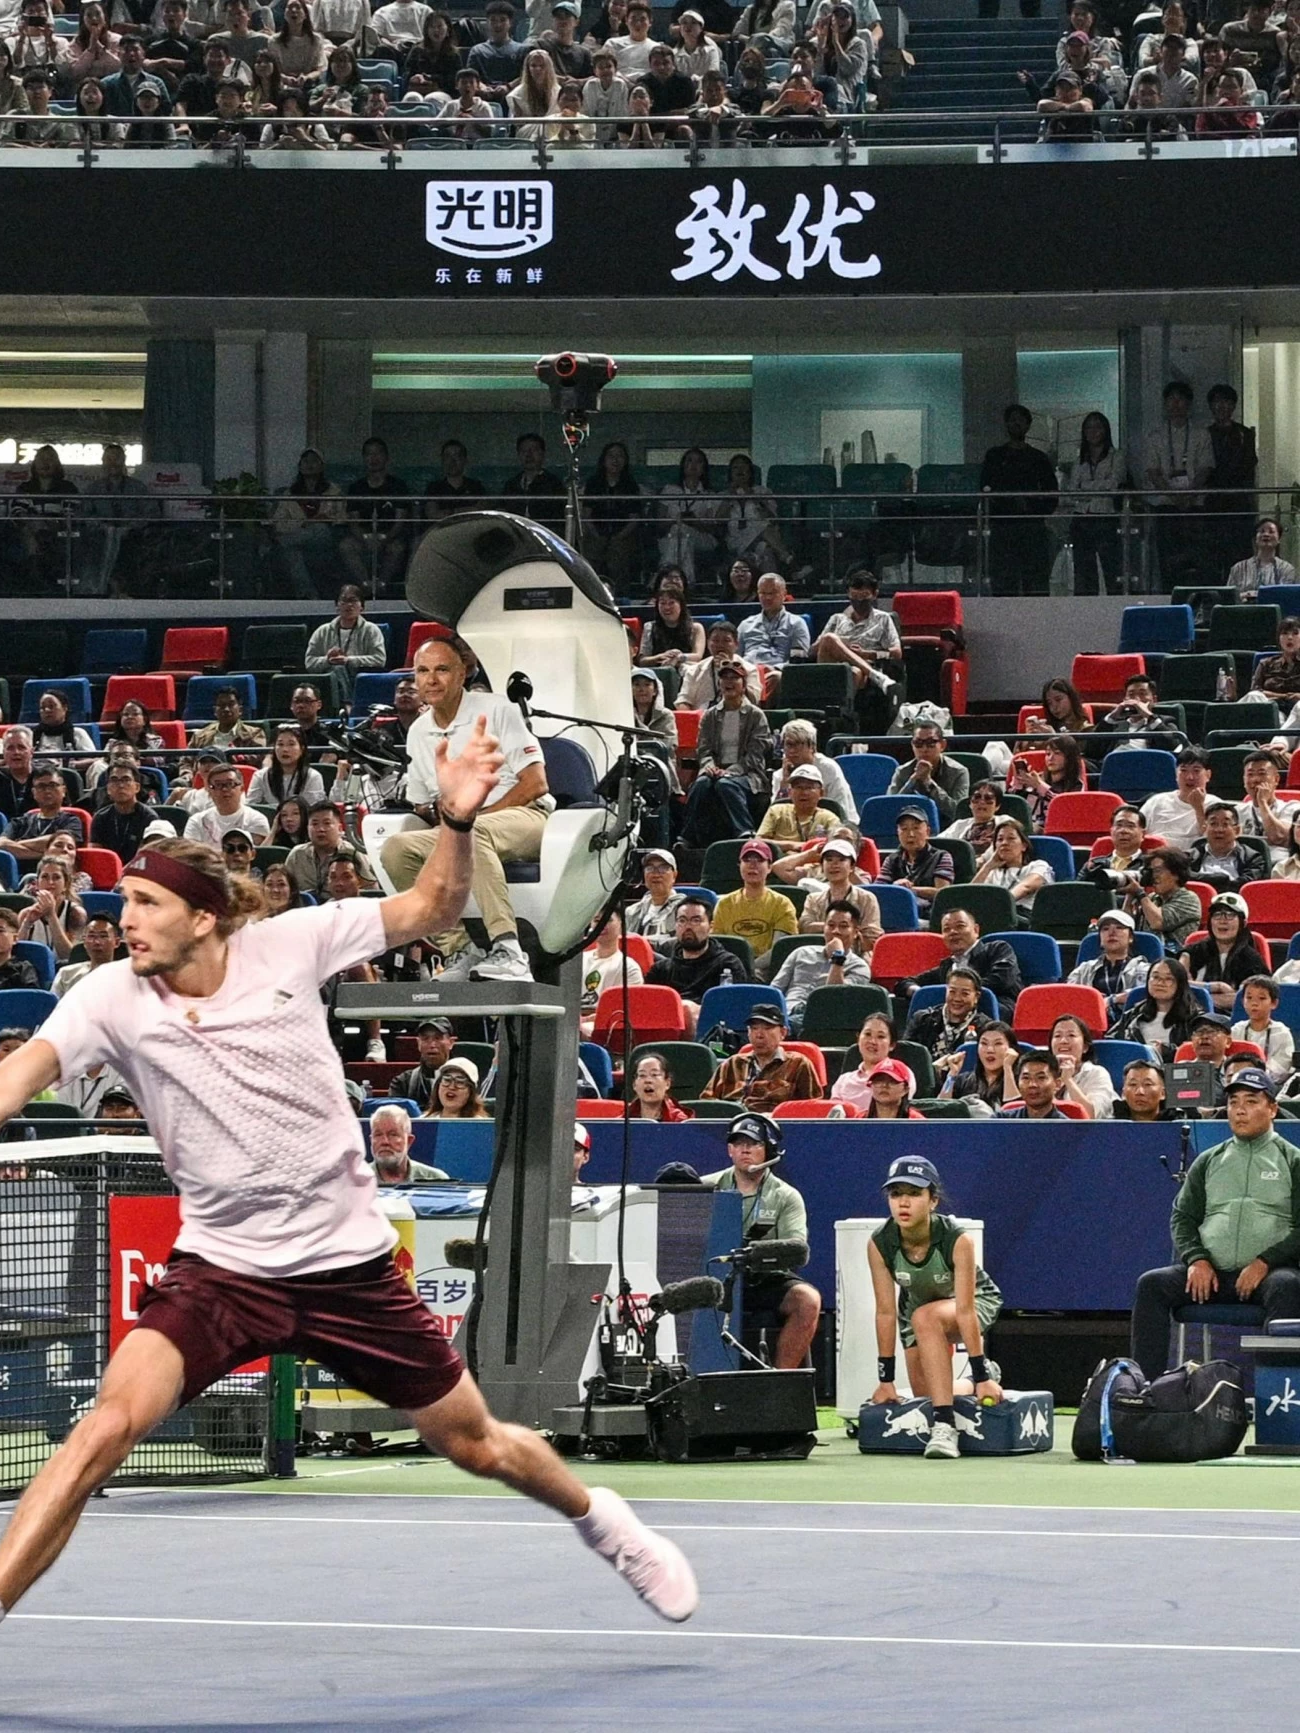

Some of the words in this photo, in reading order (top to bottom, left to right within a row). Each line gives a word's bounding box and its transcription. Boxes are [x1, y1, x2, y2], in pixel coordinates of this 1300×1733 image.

[435, 188, 542, 230] 光明
[671, 178, 881, 281] 致优
[434, 267, 543, 284] 乐在新鲜
[907, 1165, 924, 1175] EA7
[1260, 1171, 1280, 1180] EA7
[758, 1209, 776, 1218] EA7
[416, 1279, 475, 1304] 百岁
